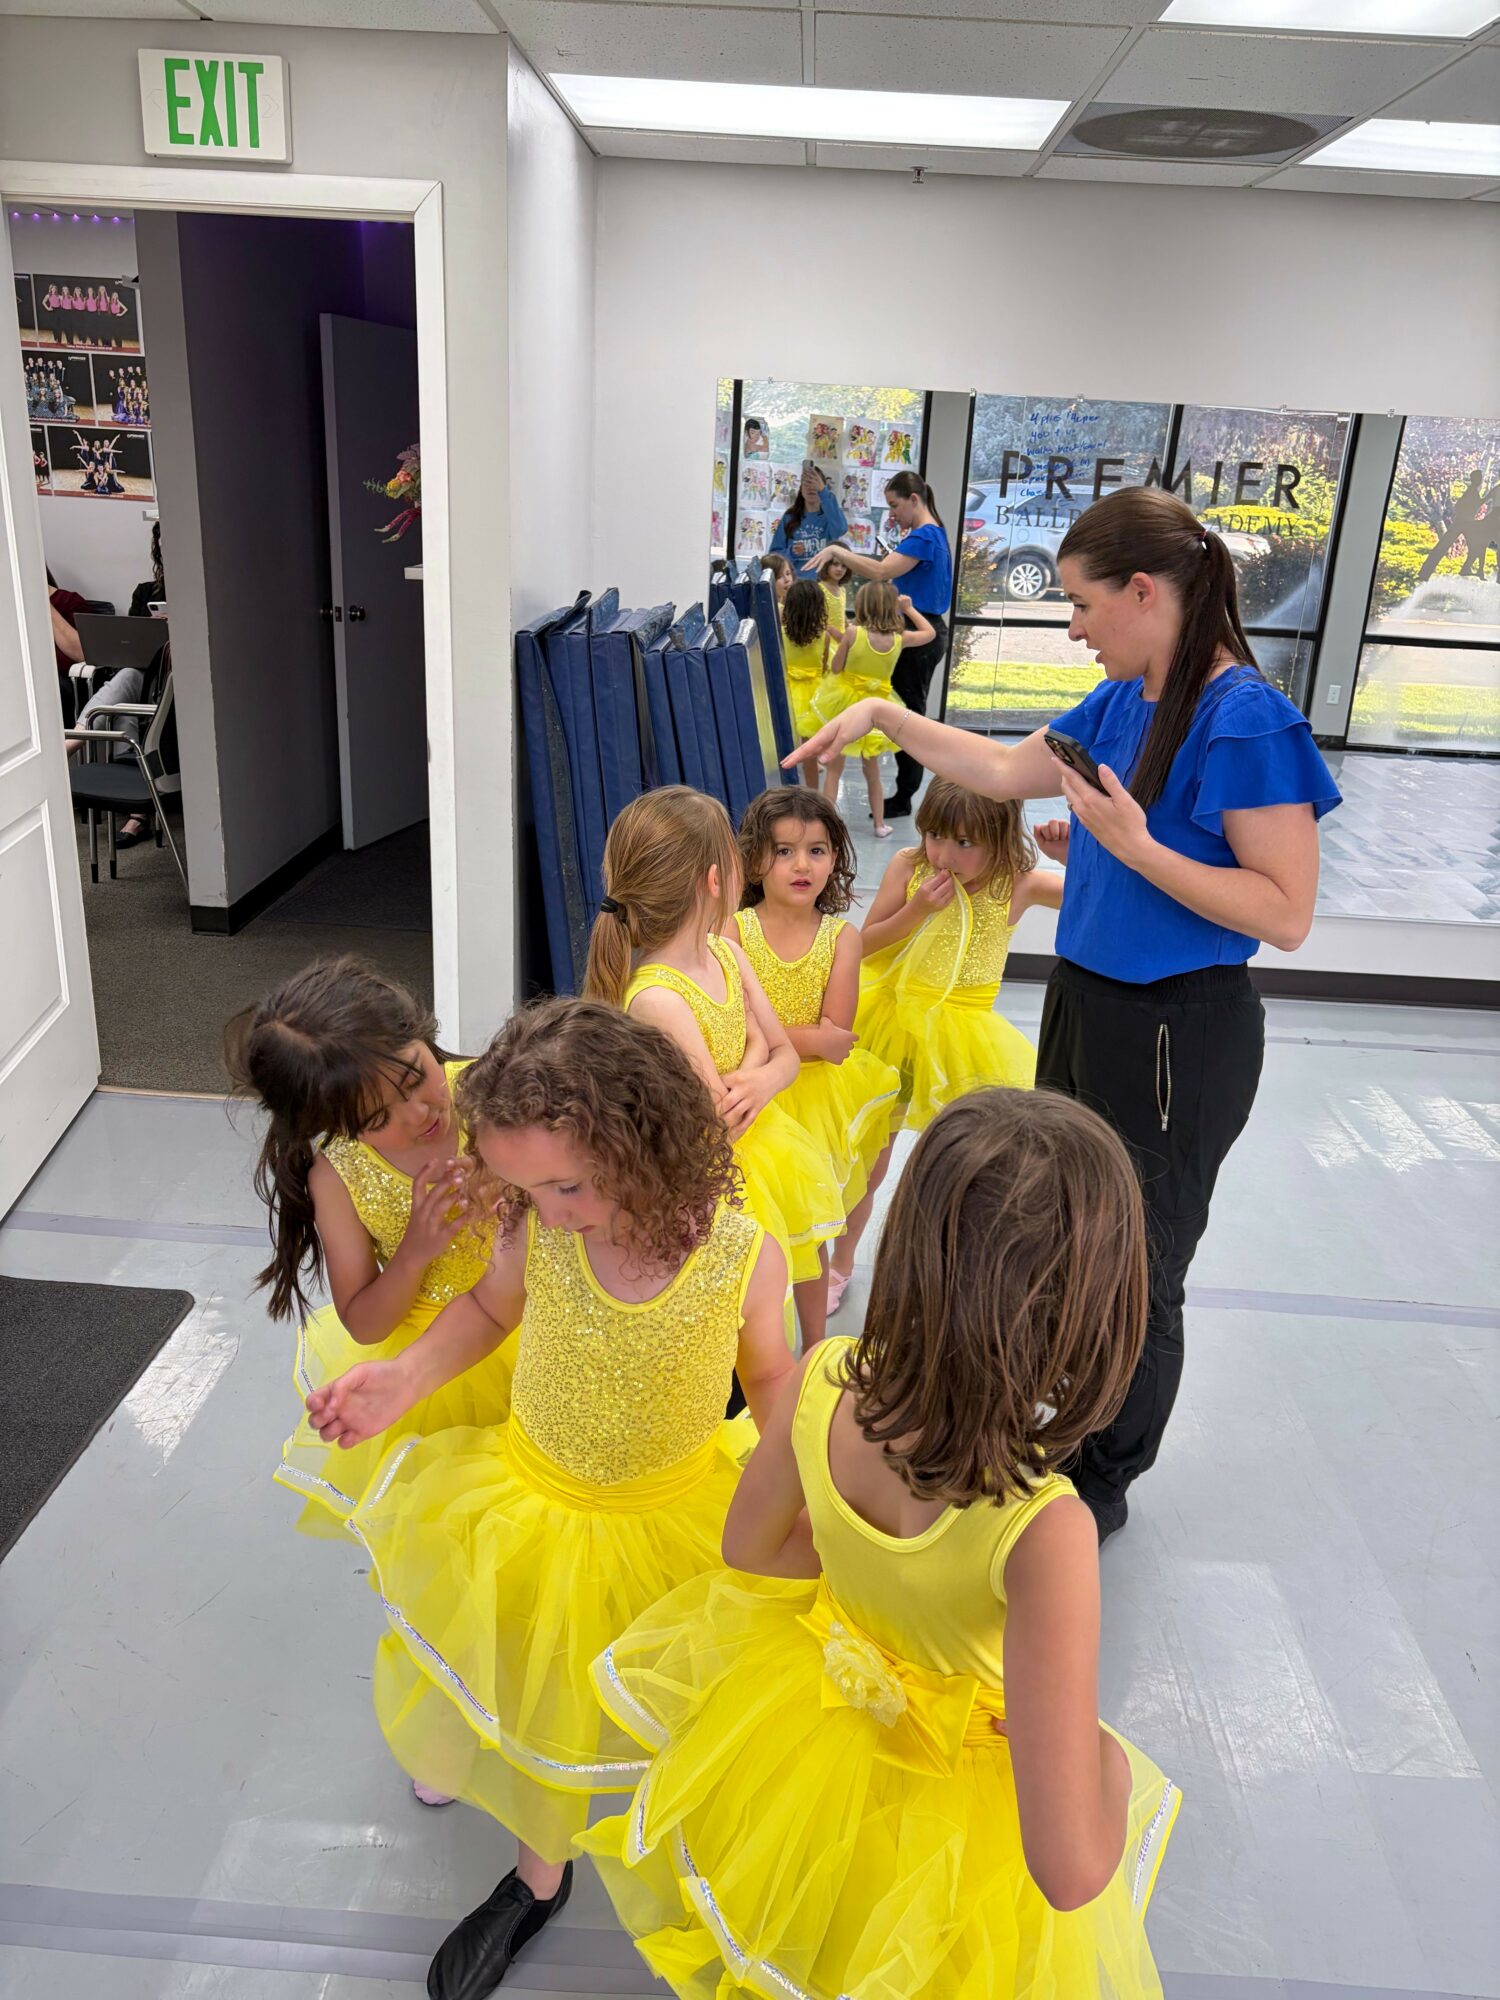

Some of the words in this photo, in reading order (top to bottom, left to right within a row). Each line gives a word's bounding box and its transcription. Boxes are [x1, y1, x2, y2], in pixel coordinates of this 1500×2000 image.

[163, 57, 264, 149] EXIT
[999, 449, 1302, 509] PREMIER
[994, 504, 1083, 530] BALLR
[1196, 513, 1301, 537] ADEMY
